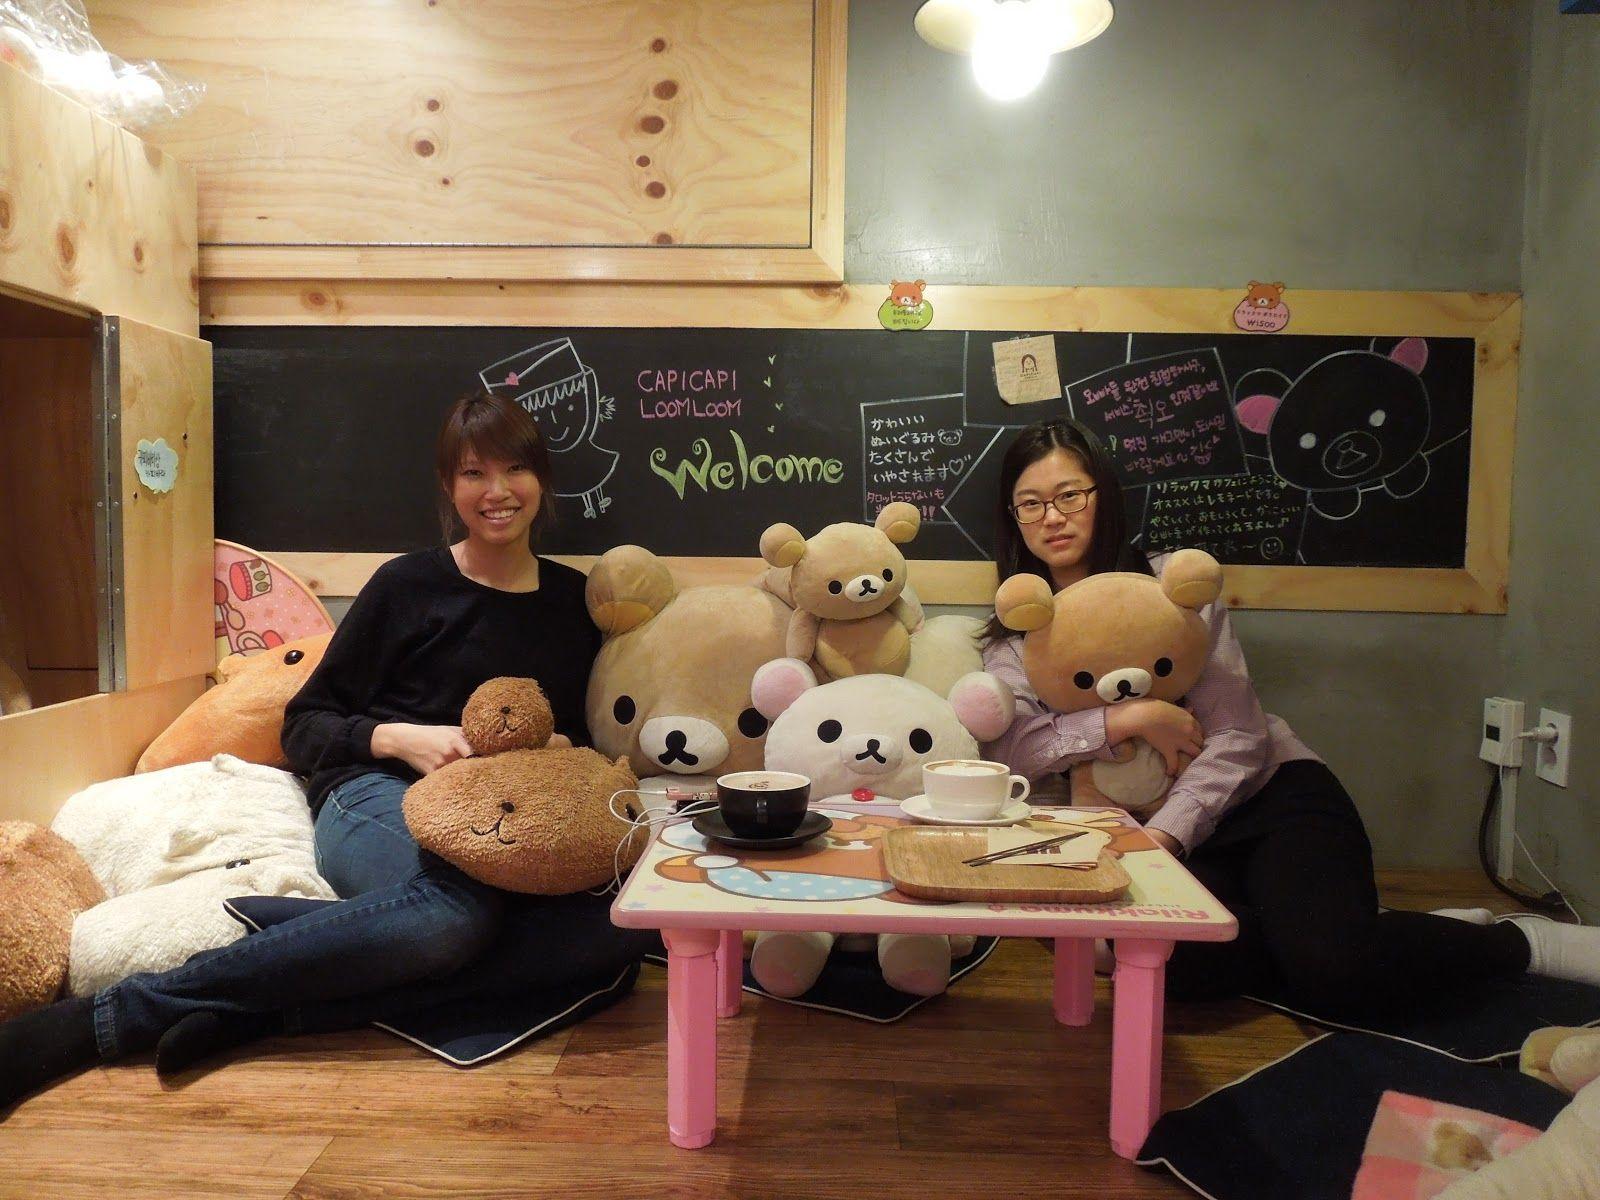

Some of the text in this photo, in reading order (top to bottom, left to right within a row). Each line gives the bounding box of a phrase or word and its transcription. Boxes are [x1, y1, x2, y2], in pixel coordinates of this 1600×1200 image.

[637, 369, 737, 392] CAPICAPI
[871, 414, 926, 431] かわいい
[870, 432, 935, 447] ぬいぐるみ
[649, 429, 844, 501] Welcome
[869, 448, 934, 464] たくさんで
[873, 464, 949, 484] いやされます
